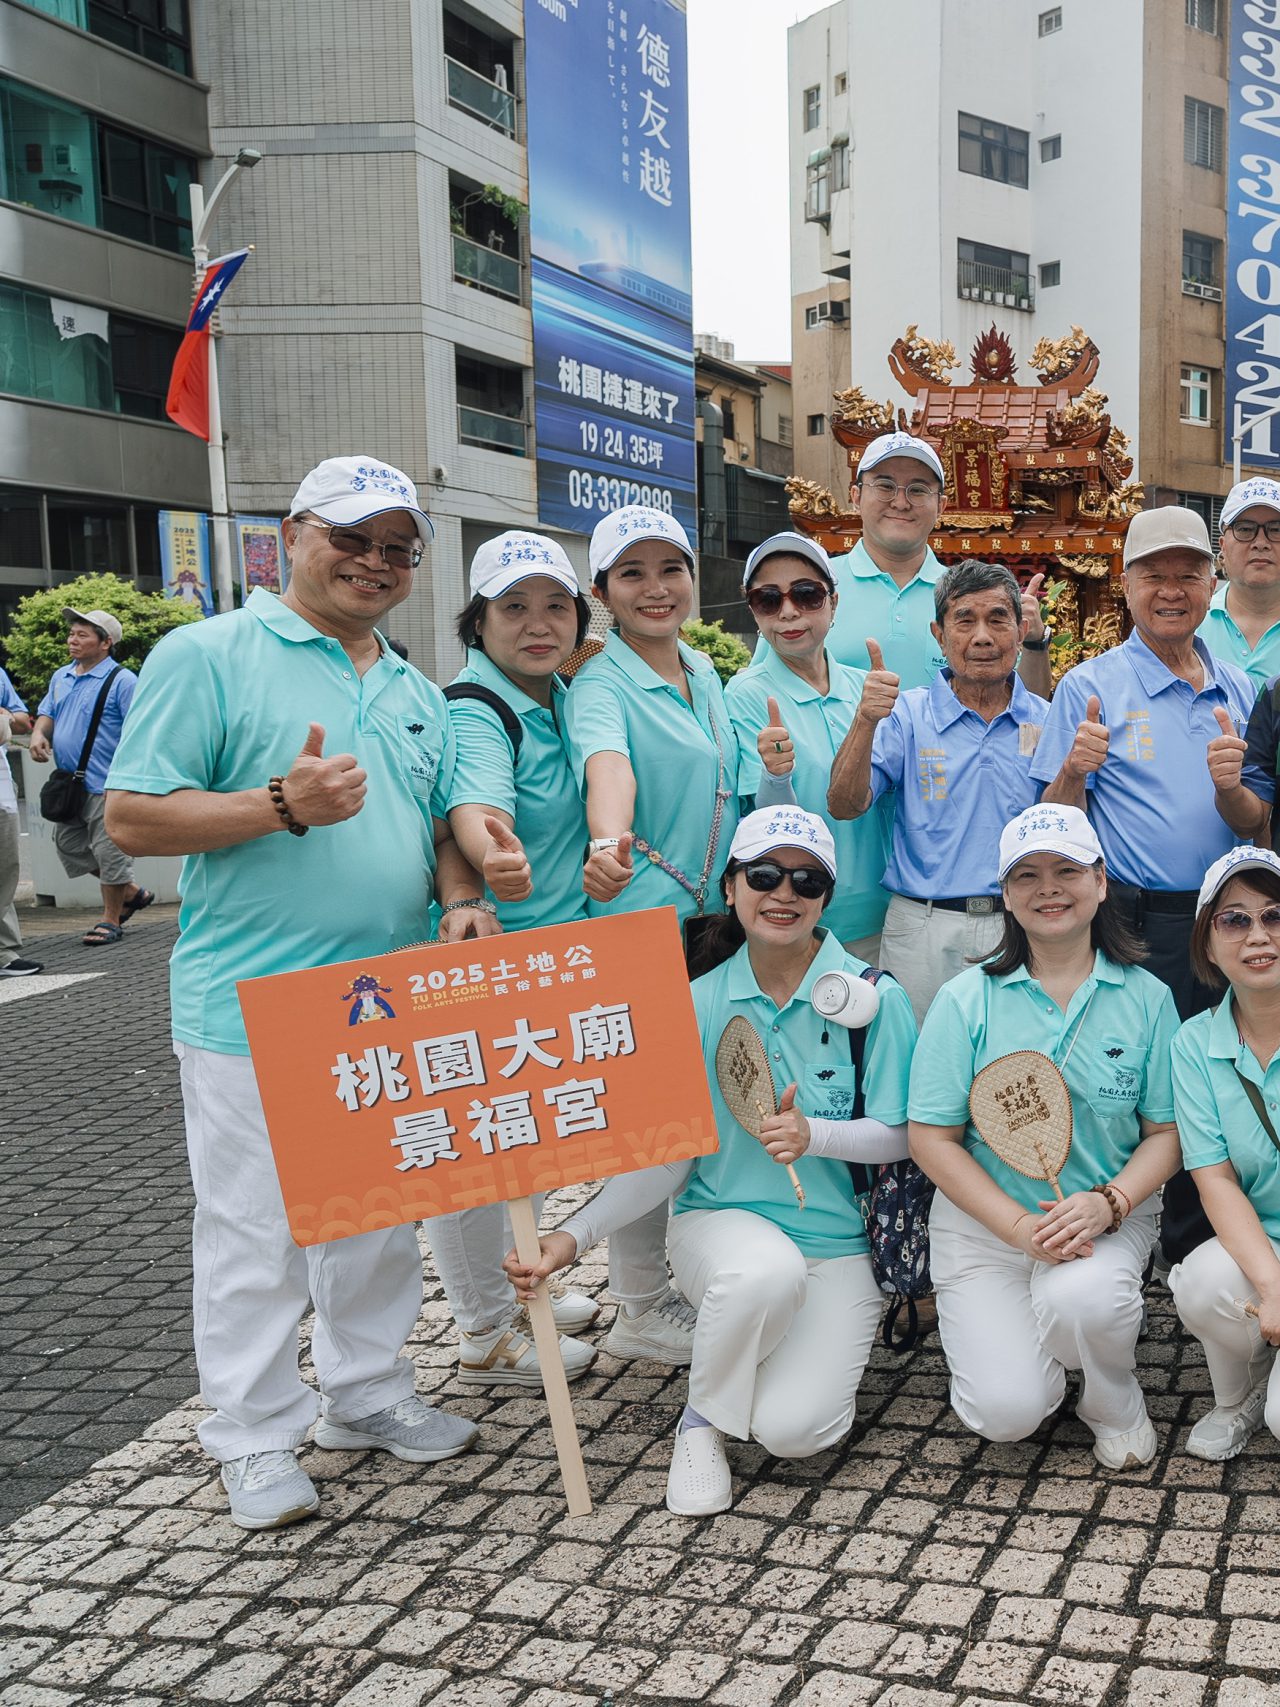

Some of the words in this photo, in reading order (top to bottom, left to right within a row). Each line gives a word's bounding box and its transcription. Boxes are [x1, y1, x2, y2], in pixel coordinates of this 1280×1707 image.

[636, 23, 673, 207] 德友越
[62, 315, 77, 334] 速
[558, 355, 679, 424] 桃園捷運來了
[964, 449, 981, 508] 景福宮
[407, 962, 486, 995] 2025
[490, 944, 594, 982] 土地公
[411, 994, 430, 1005] TU
[433, 991, 448, 1002] DI
[451, 983, 489, 998] GONG
[493, 967, 597, 996] 民俗藝術節
[413, 1003, 433, 1011] FOLK
[434, 999, 454, 1008] ARTS
[455, 993, 490, 1005] FESTIVAL
[330, 1002, 637, 1112] 桃園大廟
[390, 1078, 610, 1172] 景福宮
